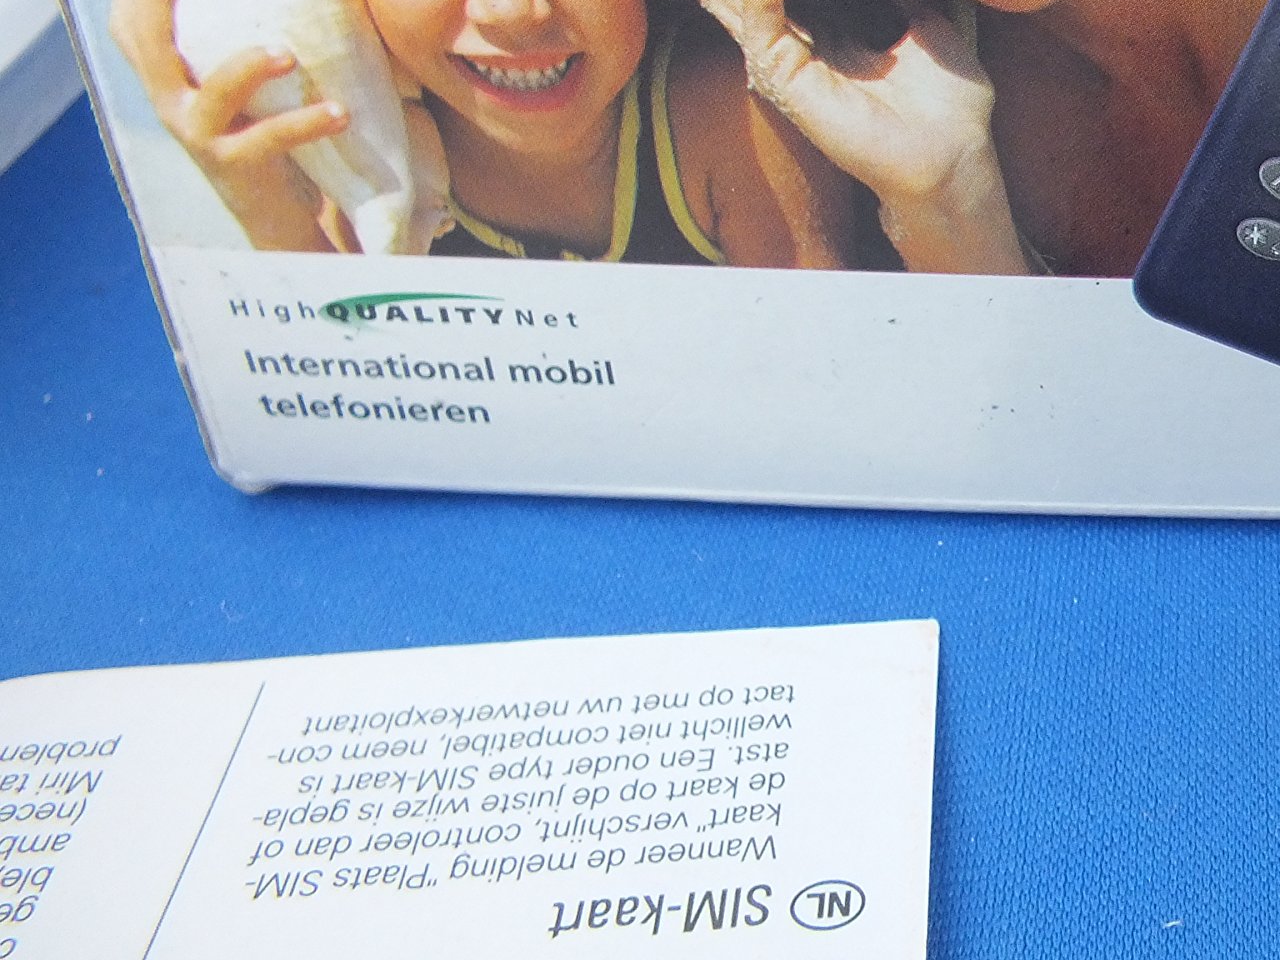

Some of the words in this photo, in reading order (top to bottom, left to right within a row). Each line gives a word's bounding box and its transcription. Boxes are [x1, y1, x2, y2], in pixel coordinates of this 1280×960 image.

[244, 350, 495, 381] International
[509, 360, 616, 385] mobil
[259, 394, 490, 423] telefonieren
[577, 696, 623, 715] uw
[632, 692, 689, 713] met
[699, 685, 733, 707] op
[744, 684, 795, 705] tact
[302, 700, 568, 736] netwerkexploitant
[681, 713, 792, 741] wellicht
[441, 725, 609, 760] compatibel,
[619, 722, 672, 745] niet
[267, 744, 332, 764] con-
[341, 738, 427, 760] neem
[660, 748, 715, 772] Een
[728, 742, 790, 765] atst.
[489, 755, 552, 780] type
[562, 752, 649, 779] ouder
[298, 774, 323, 798] is
[331, 765, 479, 794] SIM-kaart
[620, 778, 657, 801] op
[667, 776, 739, 801] kaart
[749, 771, 785, 795] de
[392, 793, 470, 822] wijze
[481, 784, 566, 815] juiste
[572, 785, 610, 810] de
[253, 798, 350, 832] gepla-
[357, 802, 383, 826] is
[535, 811, 688, 843] verschijnt,
[696, 802, 781, 833] kaart"
[294, 835, 352, 861] dan
[359, 822, 521, 855] controleer
[634, 835, 777, 864] Wanneer
[247, 840, 284, 866] of
[450, 850, 577, 882] melding
[587, 847, 626, 874] de
[245, 869, 323, 900] SIM-
[333, 863, 438, 890] "Plaats
[548, 884, 772, 938] SIM-kaart
[806, 890, 851, 918] NL
